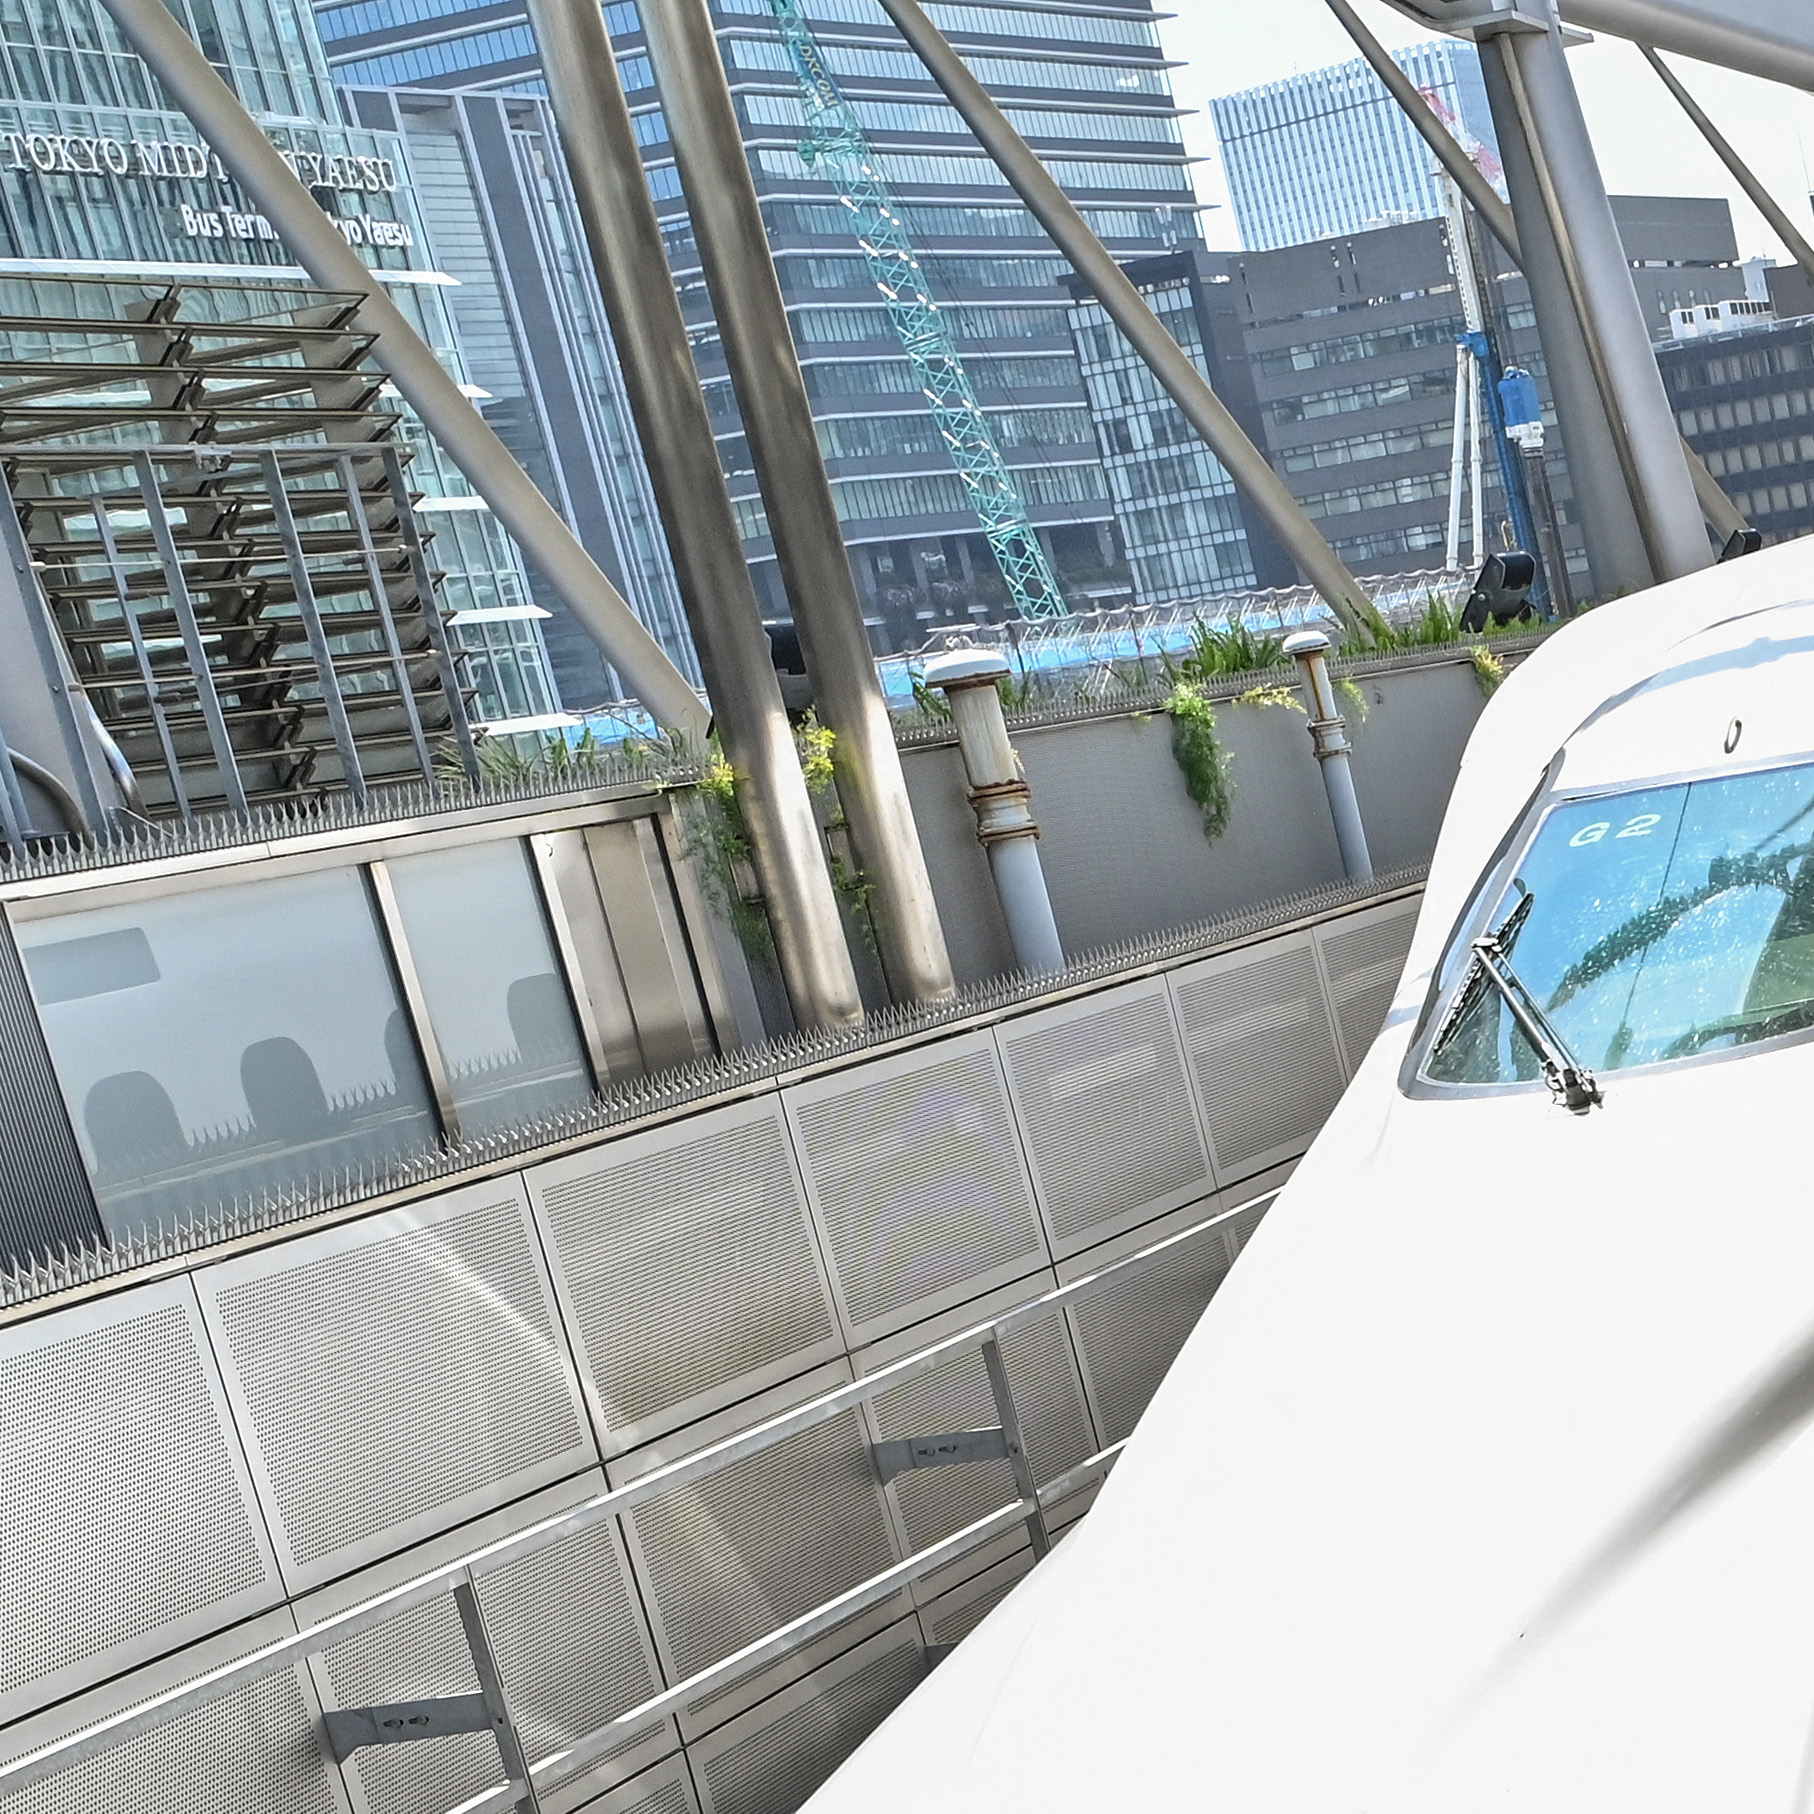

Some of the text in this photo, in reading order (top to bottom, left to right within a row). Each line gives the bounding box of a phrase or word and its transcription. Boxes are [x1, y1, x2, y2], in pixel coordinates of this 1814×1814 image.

[2, 132, 128, 175] TOKYO
[308, 151, 397, 191] YAESU
[180, 204, 224, 238] Bus
[357, 213, 414, 248] Yaesu
[1568, 813, 1662, 847] G2
